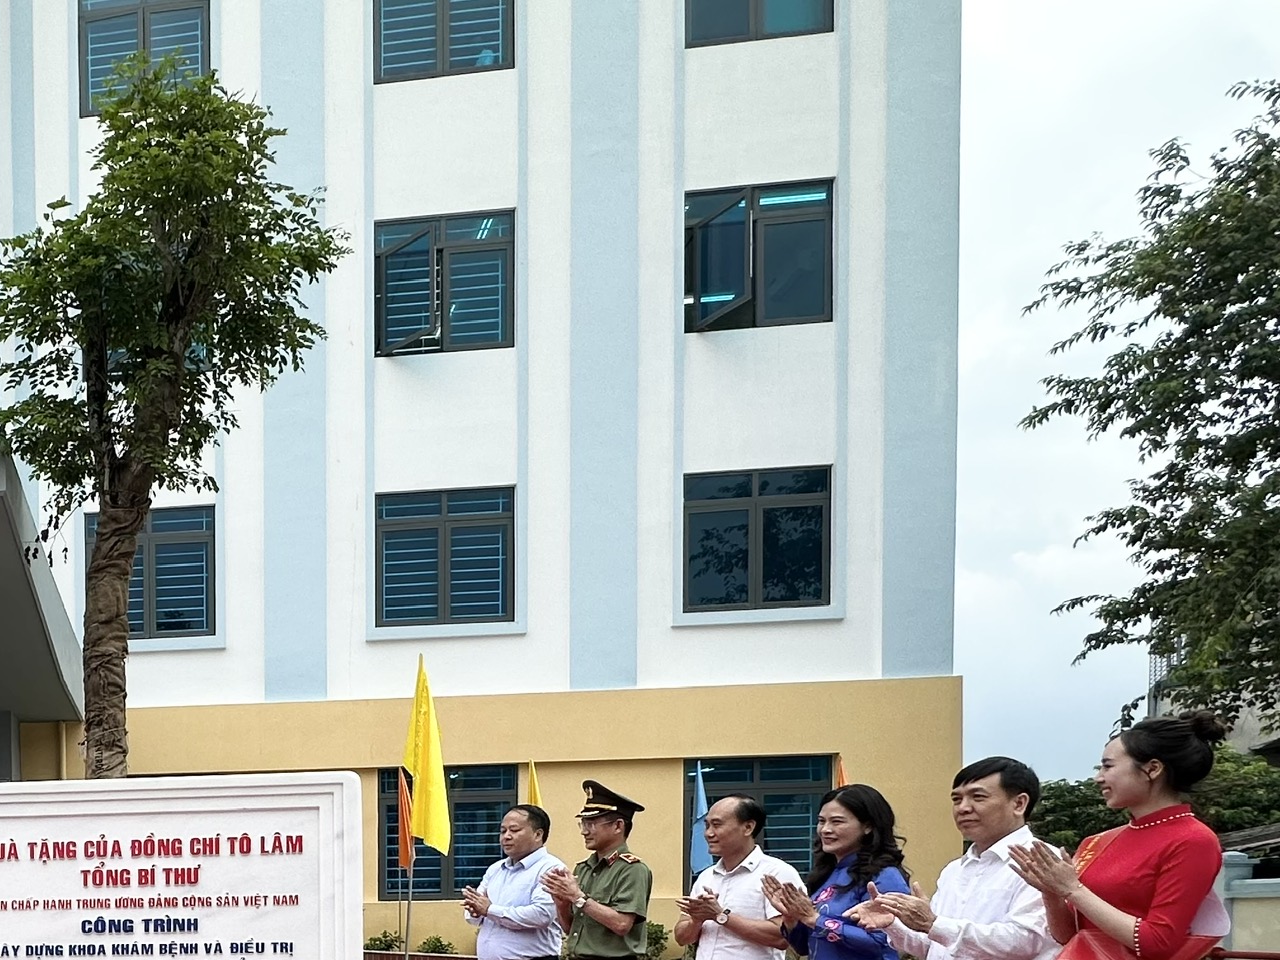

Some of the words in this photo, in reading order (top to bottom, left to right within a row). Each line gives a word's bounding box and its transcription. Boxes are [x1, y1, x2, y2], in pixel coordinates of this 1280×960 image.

[27, 839, 77, 865] TẶNG
[84, 834, 122, 859] CỦA
[130, 833, 183, 858] ĐỒNG
[190, 833, 221, 856] CHÍ
[227, 833, 252, 856] TÔ
[260, 832, 303, 855] LÂM
[80, 861, 131, 887] TỔNG
[138, 865, 156, 887] BÍ
[163, 864, 201, 886] THƯ
[11, 897, 39, 911] CHẤP
[76, 898, 111, 909] TRUNG
[115, 896, 144, 908] ƯƠNG
[148, 893, 178, 908] ĐẢNG
[182, 895, 212, 910] CỘNG
[216, 892, 239, 908] SẢN
[243, 893, 268, 909] VIỆT
[273, 895, 299, 906] NAM
[81, 916, 134, 935] CÔNG
[142, 915, 198, 934] TRÌNH
[26, 943, 64, 960] DỰNG
[68, 944, 106, 957] KHOA
[111, 941, 153, 955] KHÁM
[159, 941, 198, 958] BỆNH
[204, 940, 223, 955] VÀ
[230, 938, 265, 954] ĐIỀU
[271, 942, 294, 957] TRỊ
